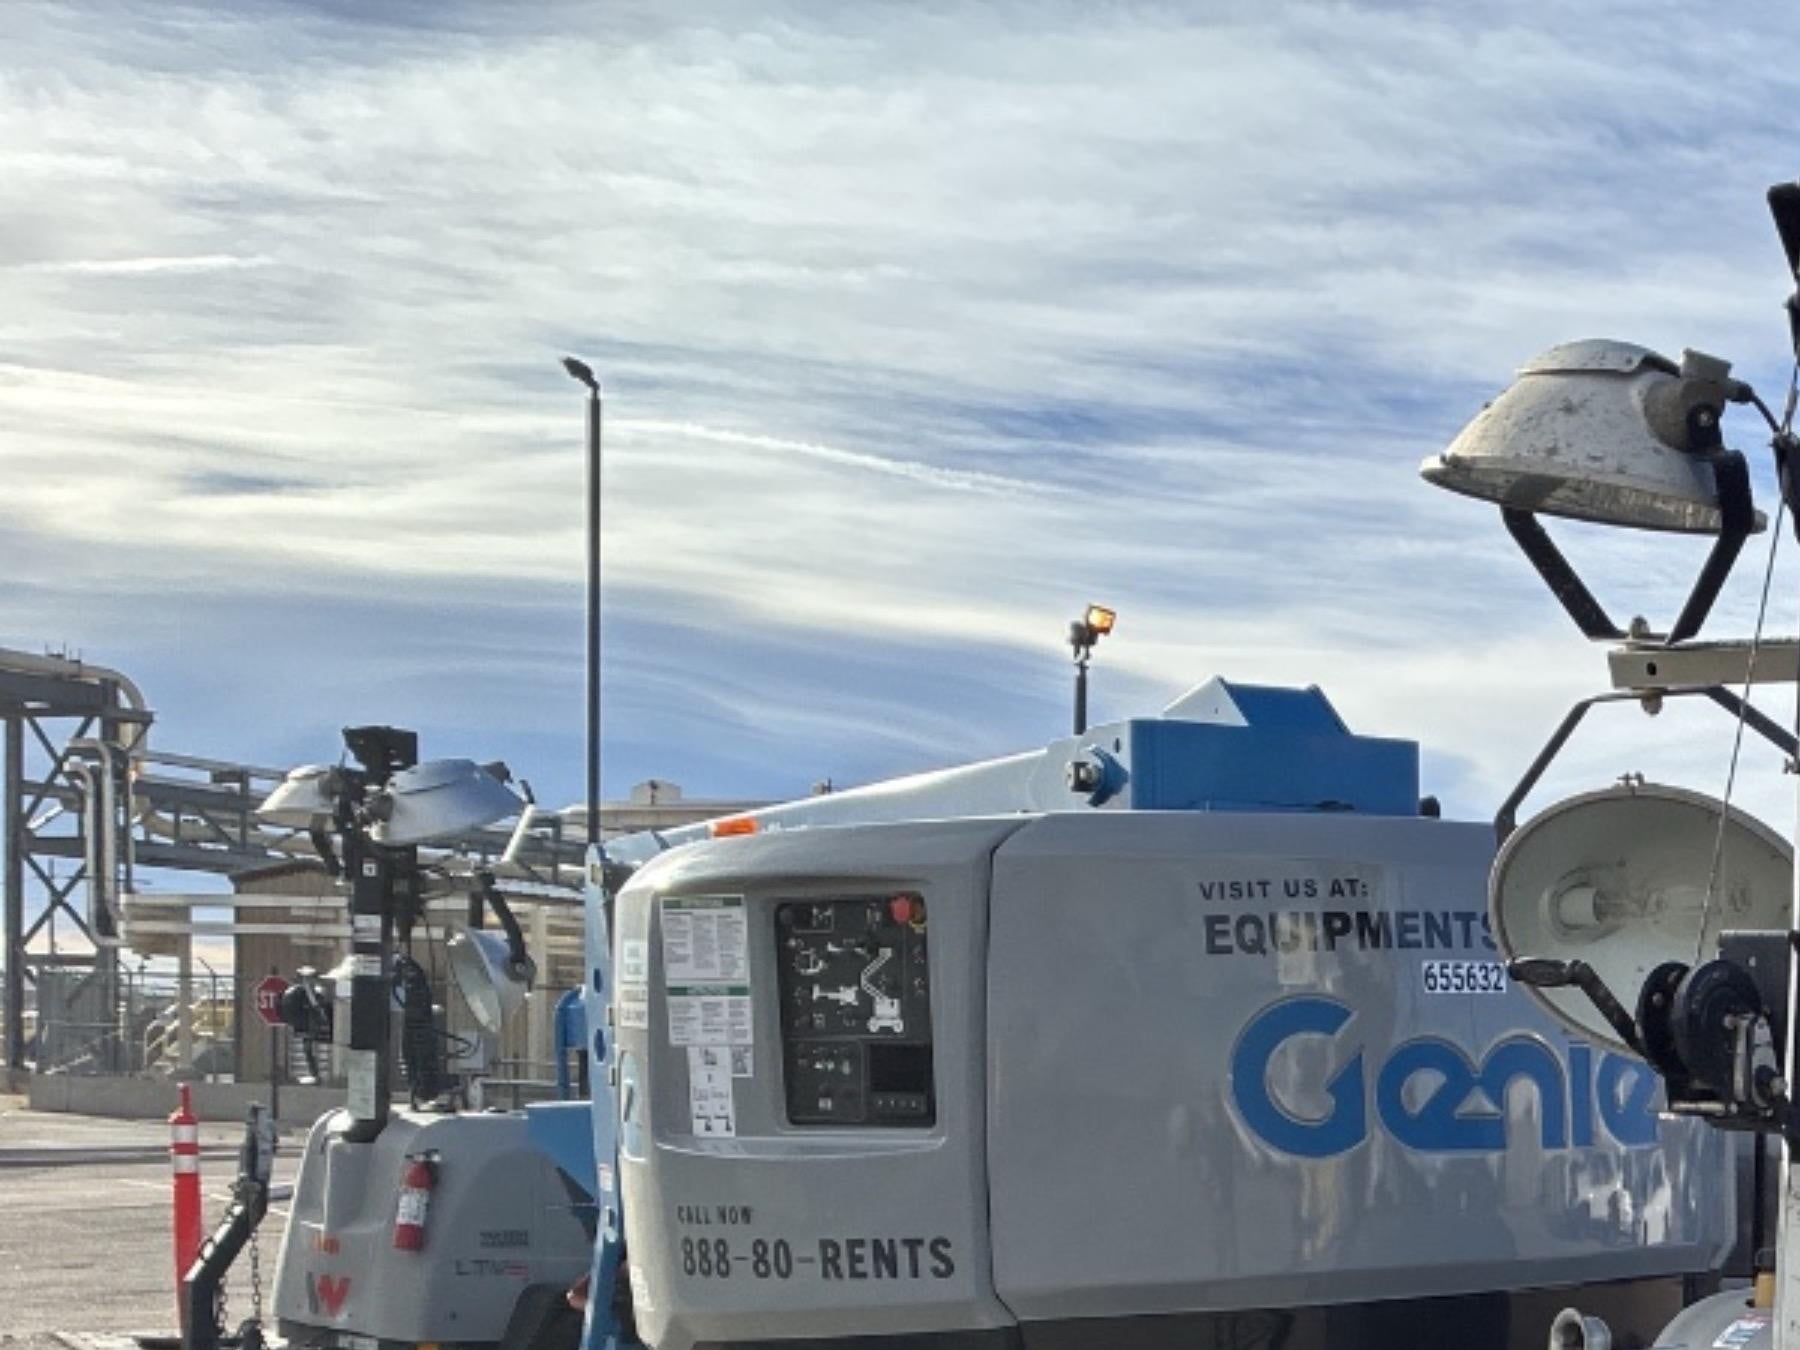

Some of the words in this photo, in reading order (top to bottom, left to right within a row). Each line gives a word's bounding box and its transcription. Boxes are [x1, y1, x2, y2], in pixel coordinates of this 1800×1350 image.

[1199, 880, 1272, 901] VISIT
[1283, 878, 1319, 899] US
[1328, 878, 1369, 898] AT:
[1423, 961, 1504, 993] 655632
[1231, 996, 1659, 1159] Genie
[677, 1205, 713, 1225] CALL
[716, 1205, 752, 1225] NOW
[680, 1235, 956, 1281] 888-80-RENTS
